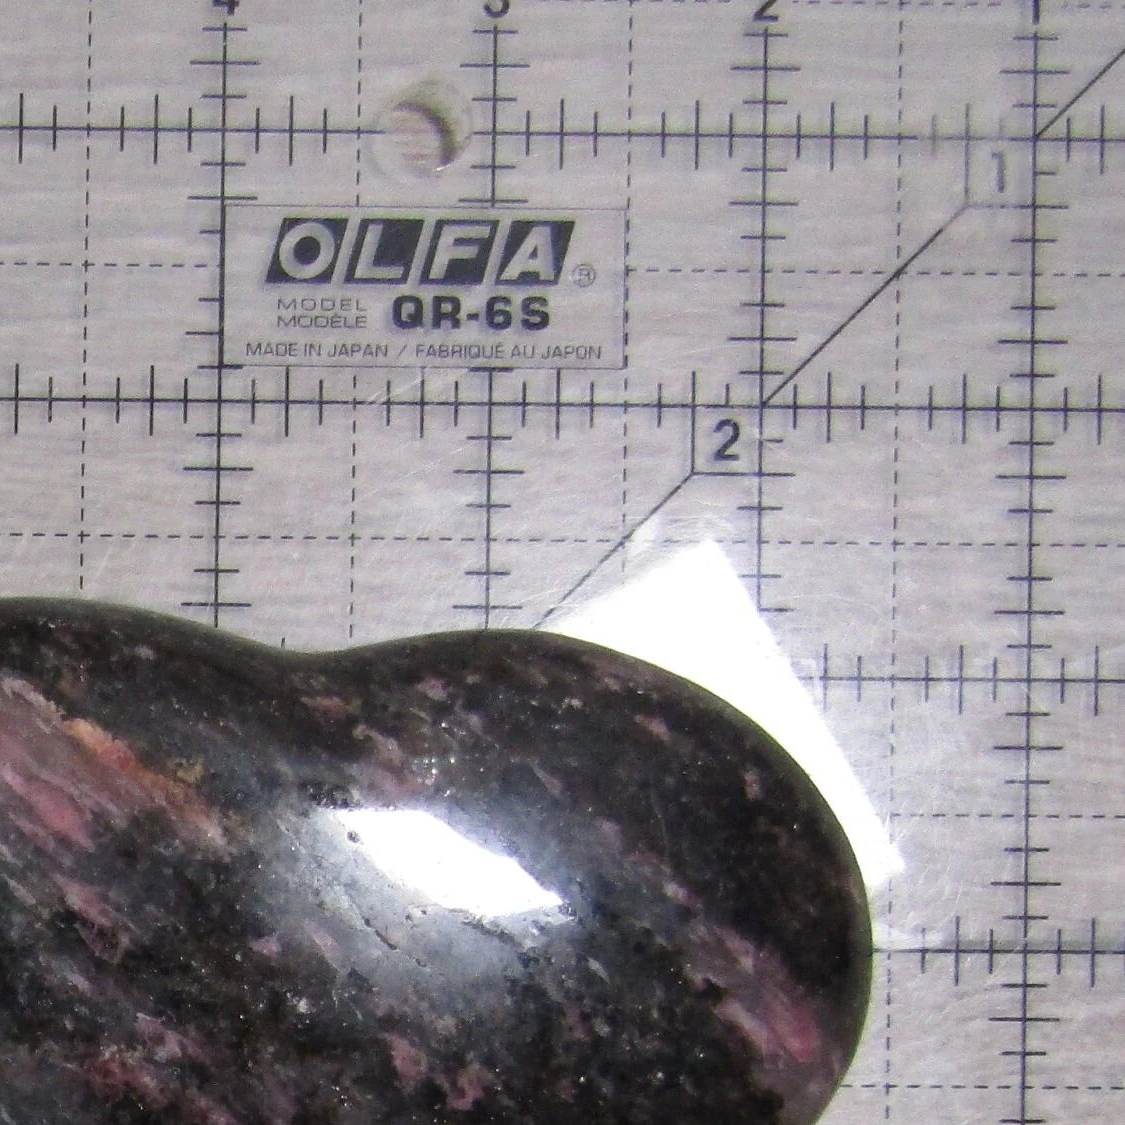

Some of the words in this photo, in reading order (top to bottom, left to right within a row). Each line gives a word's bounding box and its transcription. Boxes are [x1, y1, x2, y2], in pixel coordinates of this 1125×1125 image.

[992, 152, 1006, 192] 1
[273, 219, 565, 284] OLFA
[277, 298, 367, 312] MODEL
[277, 313, 367, 328] MODÈLE
[391, 294, 550, 332] QR-6S
[246, 342, 298, 357] MADE
[304, 343, 322, 358] IN
[327, 344, 388, 358] JAPAN
[511, 345, 535, 359] AU
[541, 346, 603, 360] JAPON
[712, 419, 741, 462] 2
